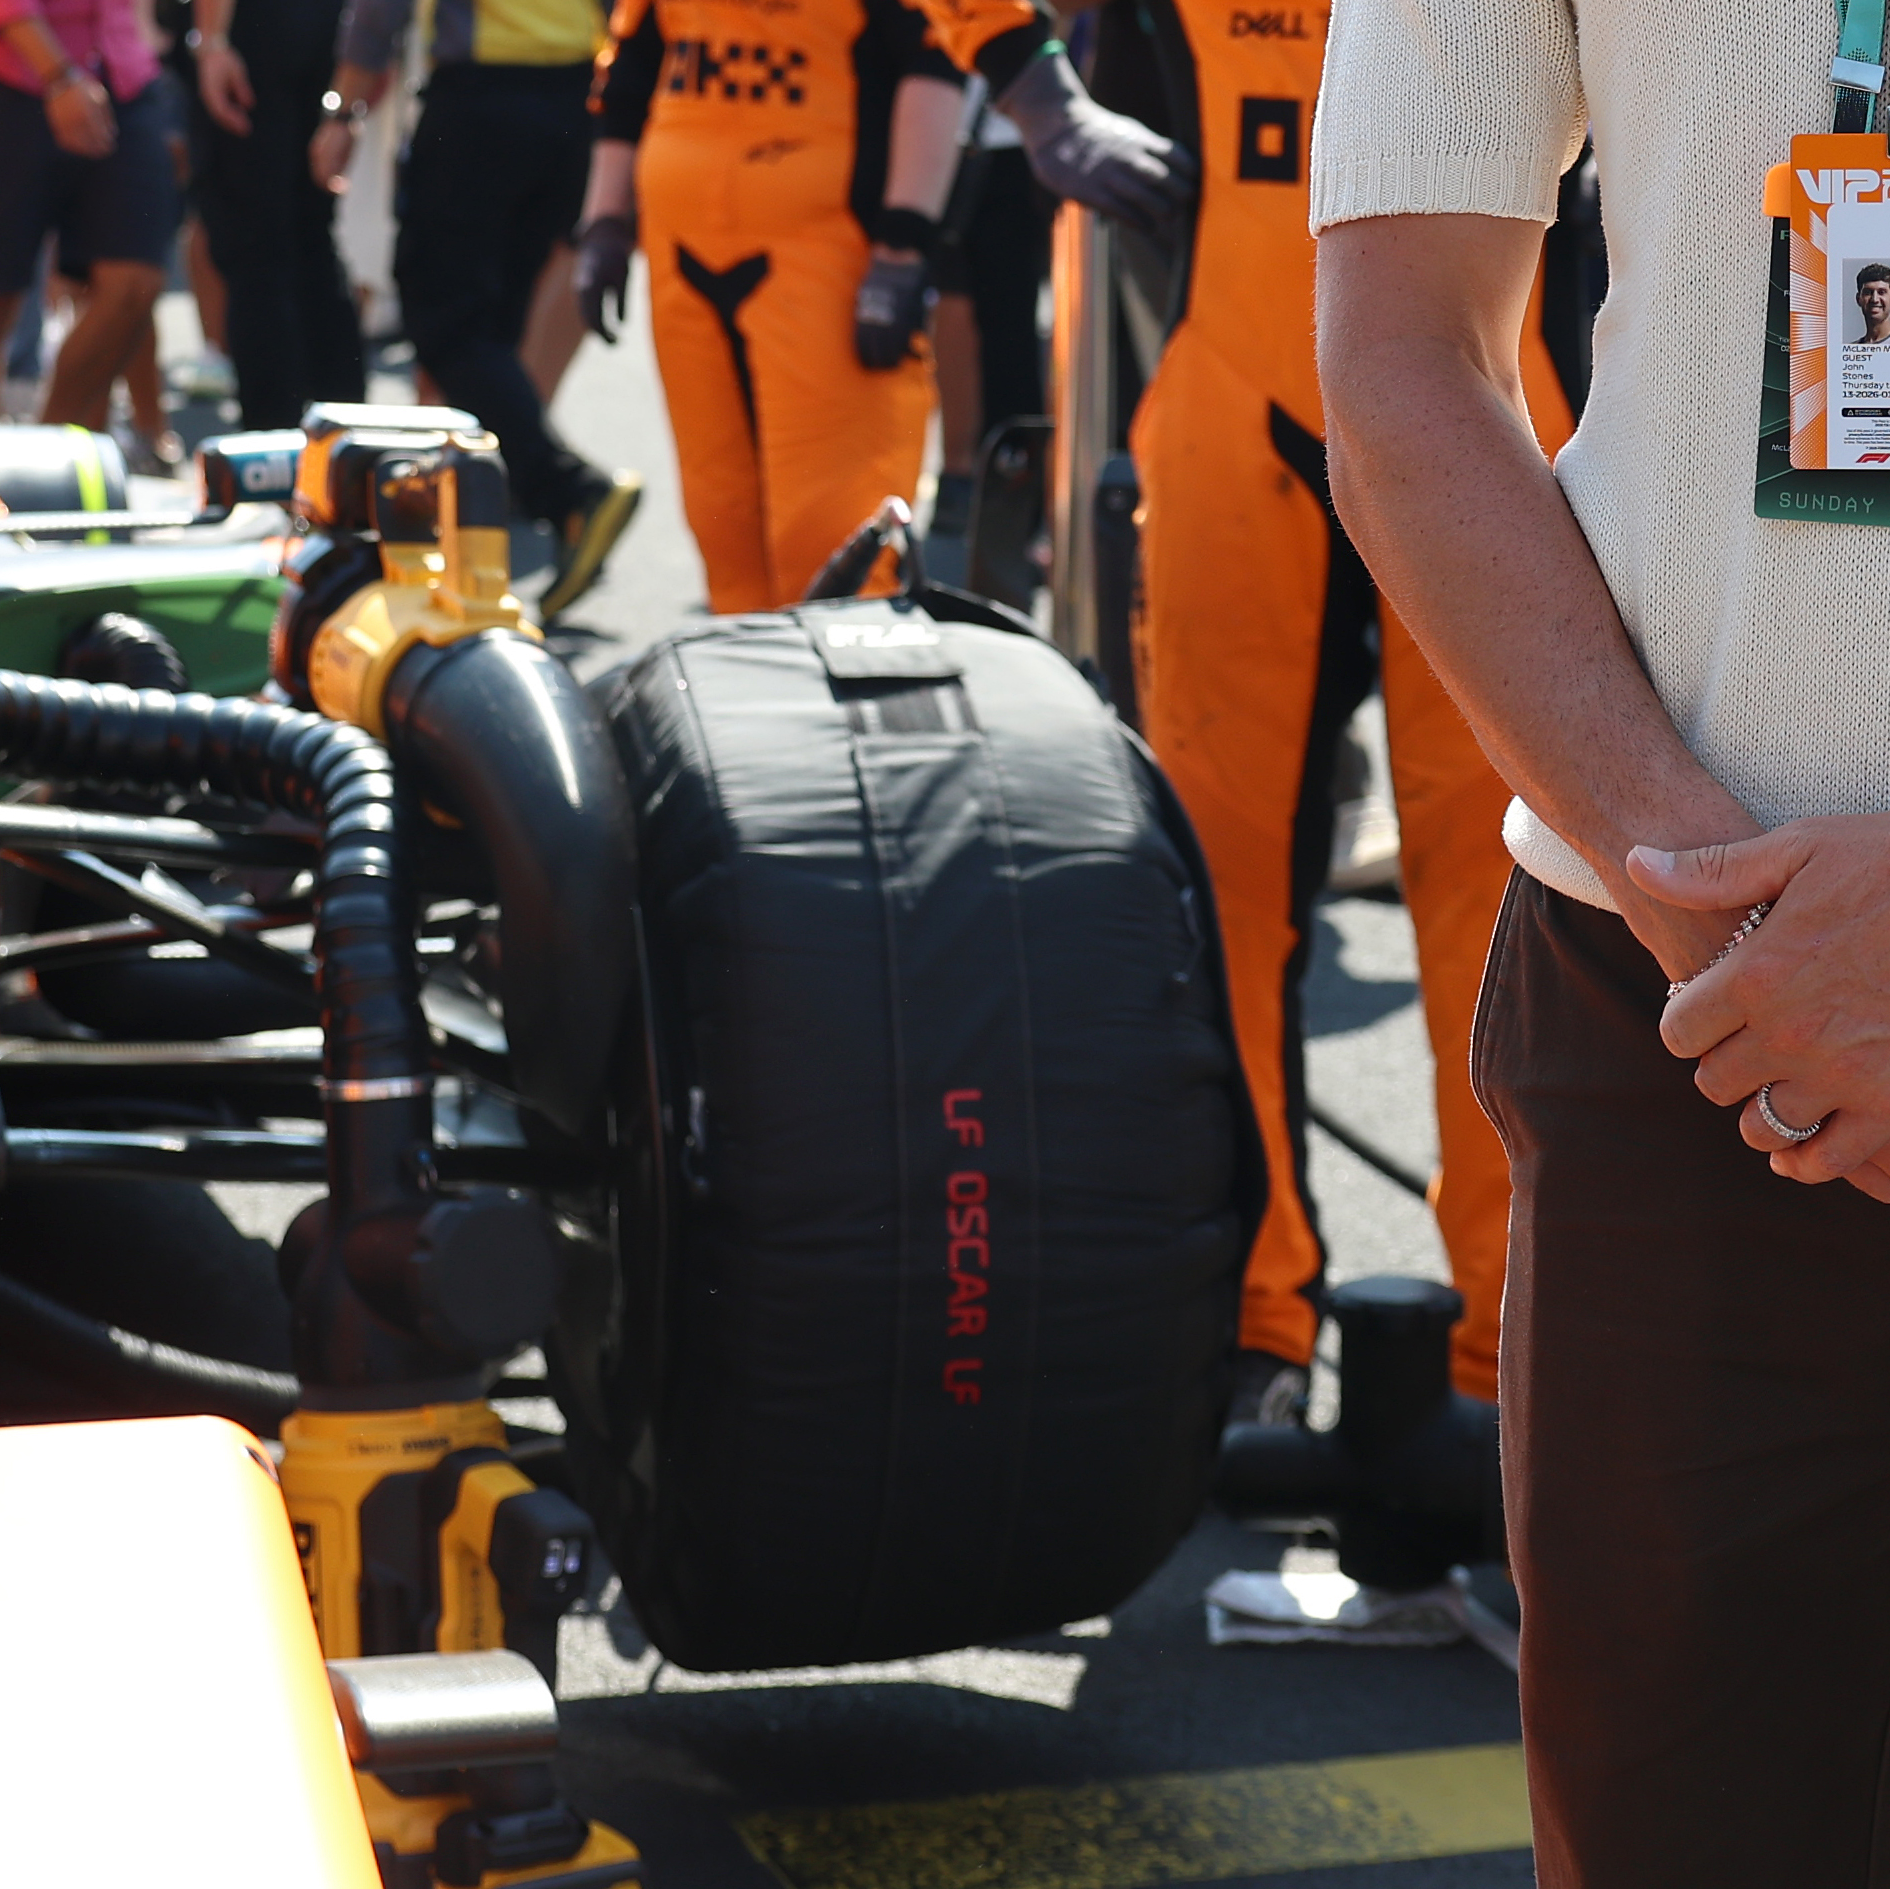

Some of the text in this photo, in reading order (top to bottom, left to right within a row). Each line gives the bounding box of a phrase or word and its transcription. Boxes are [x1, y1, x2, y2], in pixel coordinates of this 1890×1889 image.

[1842, 345, 1882, 353] McLaren
[1842, 354, 1873, 362] GUEST
[1842, 363, 1865, 371] John
[1842, 372, 1874, 380] Stones
[1842, 381, 1884, 390] Thursday
[1779, 491, 1875, 515] SUNDAY
[942, 1088, 990, 1407] LF OSCAR LF
